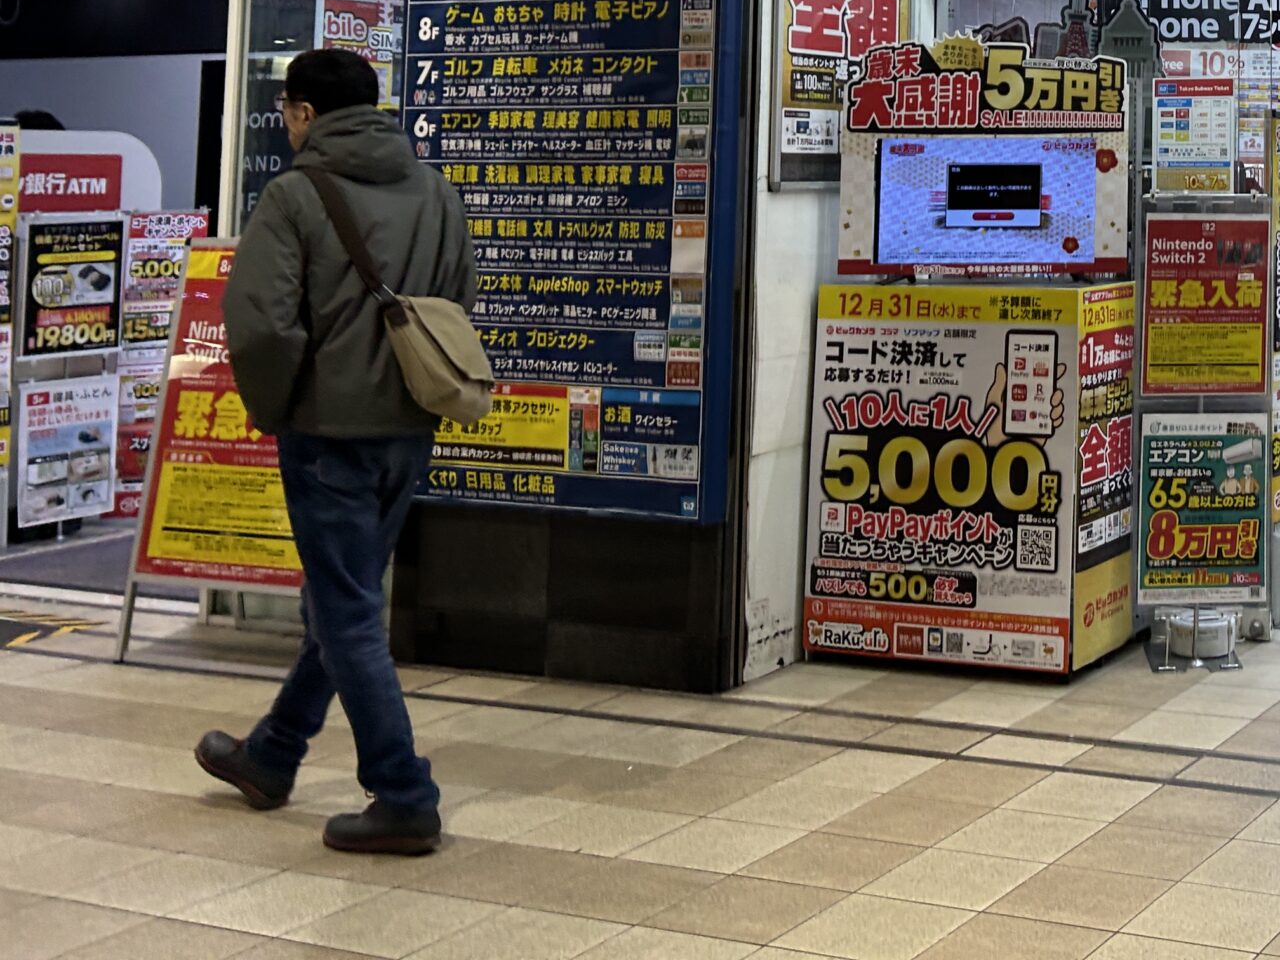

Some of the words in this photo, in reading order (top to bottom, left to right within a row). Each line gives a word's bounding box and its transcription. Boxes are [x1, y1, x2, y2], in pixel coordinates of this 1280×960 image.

[445, 3, 485, 25] ゲーム
[493, 4, 544, 24] おもちゃ
[553, 1, 587, 22] 時計
[594, 0, 670, 22] 電子ピアノ
[418, 16, 440, 42] 8F
[1112, 9, 1220, 39] hone
[416, 60, 439, 85] 7F
[443, 58, 484, 77] ゴルフ
[492, 55, 539, 77] 自転車
[548, 57, 583, 76] メガネ
[592, 55, 659, 74] コンタクト
[866, 45, 922, 81] 歳末
[983, 46, 1123, 113] 5万円引き
[851, 71, 981, 129] 大感謝
[413, 113, 436, 138] 6F
[440, 112, 482, 129] エアコン
[488, 110, 537, 130] 季節家電
[542, 110, 581, 129] 理美容
[484, 163, 520, 185] 洗濯機
[525, 163, 576, 185] 調理家電
[576, 194, 603, 207] アイロン
[606, 195, 629, 207] ミシン
[144, 227, 193, 238] キャンペーン
[497, 219, 528, 238] 電話機
[533, 219, 553, 238] 文具
[558, 220, 613, 239] トラベルグッズ
[618, 221, 641, 239] 防犯
[645, 221, 666, 240] 防災
[1152, 237, 1215, 251] Nintendo
[1151, 251, 1196, 265] Switch
[1197, 252, 1206, 264] 2
[528, 276, 590, 296] AppleShop
[596, 278, 664, 296] スマートウォッチ
[1150, 279, 1264, 309] 緊急入荷
[837, 293, 982, 320] 12月31日(水)まで
[989, 295, 1042, 308] ※予算額に
[998, 307, 1064, 322] 達し次第終了
[526, 328, 595, 351] プロジェクター
[835, 326, 876, 336] ビックカメラ
[903, 328, 941, 338] ソフマップ
[943, 328, 977, 340] 店舗限定
[824, 339, 967, 368] コード決済して
[1012, 342, 1051, 353] コード決済
[823, 366, 912, 385] 応募するだけ!
[491, 399, 560, 417] 携帯アクセサリー
[604, 405, 632, 425] お酒
[634, 413, 678, 427] ワインセラー
[441, 445, 511, 460] 総合案内カウンター
[603, 455, 637, 467] Whiskey
[1080, 417, 1134, 486] 全額
[1148, 448, 1205, 463] エアコン
[428, 470, 458, 488] くすり
[465, 471, 506, 490] 日用品
[513, 473, 556, 496] 化粧品
[822, 433, 1062, 512] 5,000円分
[1149, 477, 1256, 510] 65歳以上の方は
[846, 502, 1015, 544] PayPayポイントが
[819, 533, 1015, 567] 当たっちゃうキャンペーン
[815, 578, 867, 596] ハズレでも
